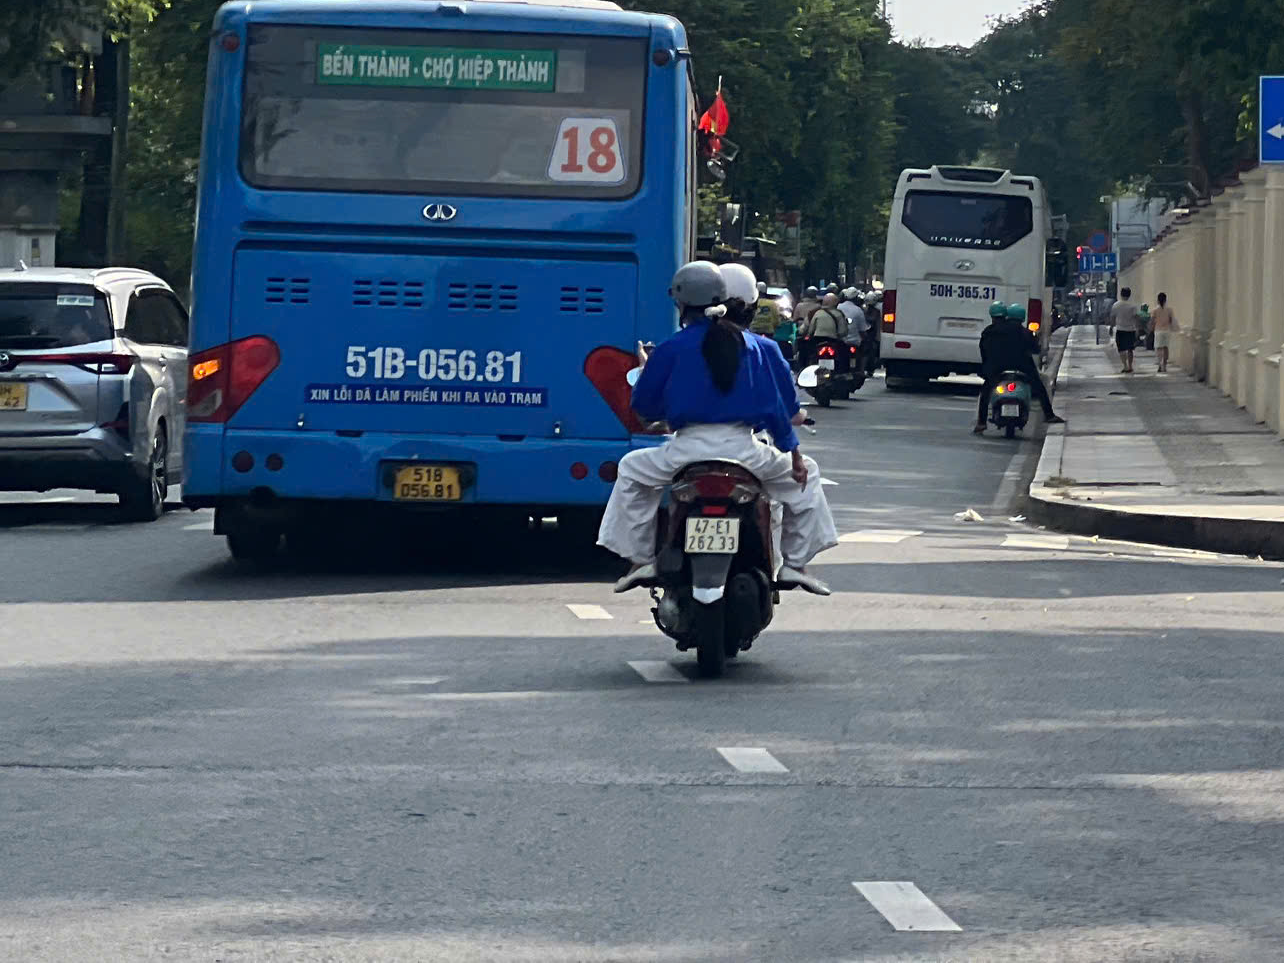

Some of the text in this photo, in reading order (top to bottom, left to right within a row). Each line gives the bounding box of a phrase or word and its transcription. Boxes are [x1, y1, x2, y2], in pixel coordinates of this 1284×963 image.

[322, 45, 354, 76] BẾN
[358, 50, 410, 78] THÀNH
[422, 55, 454, 85] CHỢ
[458, 55, 493, 86] HIỆP
[497, 55, 549, 83] THÀNH
[560, 126, 616, 174] 18
[930, 284, 996, 300] 50H-365.31
[345, 345, 521, 383] 51B-056.81
[310, 384, 542, 406] XIN LỖI ĐÃ LÀM PHIỀN KHI RA VÀO TRẠM
[413, 468, 442, 482] 51B
[401, 483, 453, 498] 056.81
[695, 519, 730, 535] 47-E1
